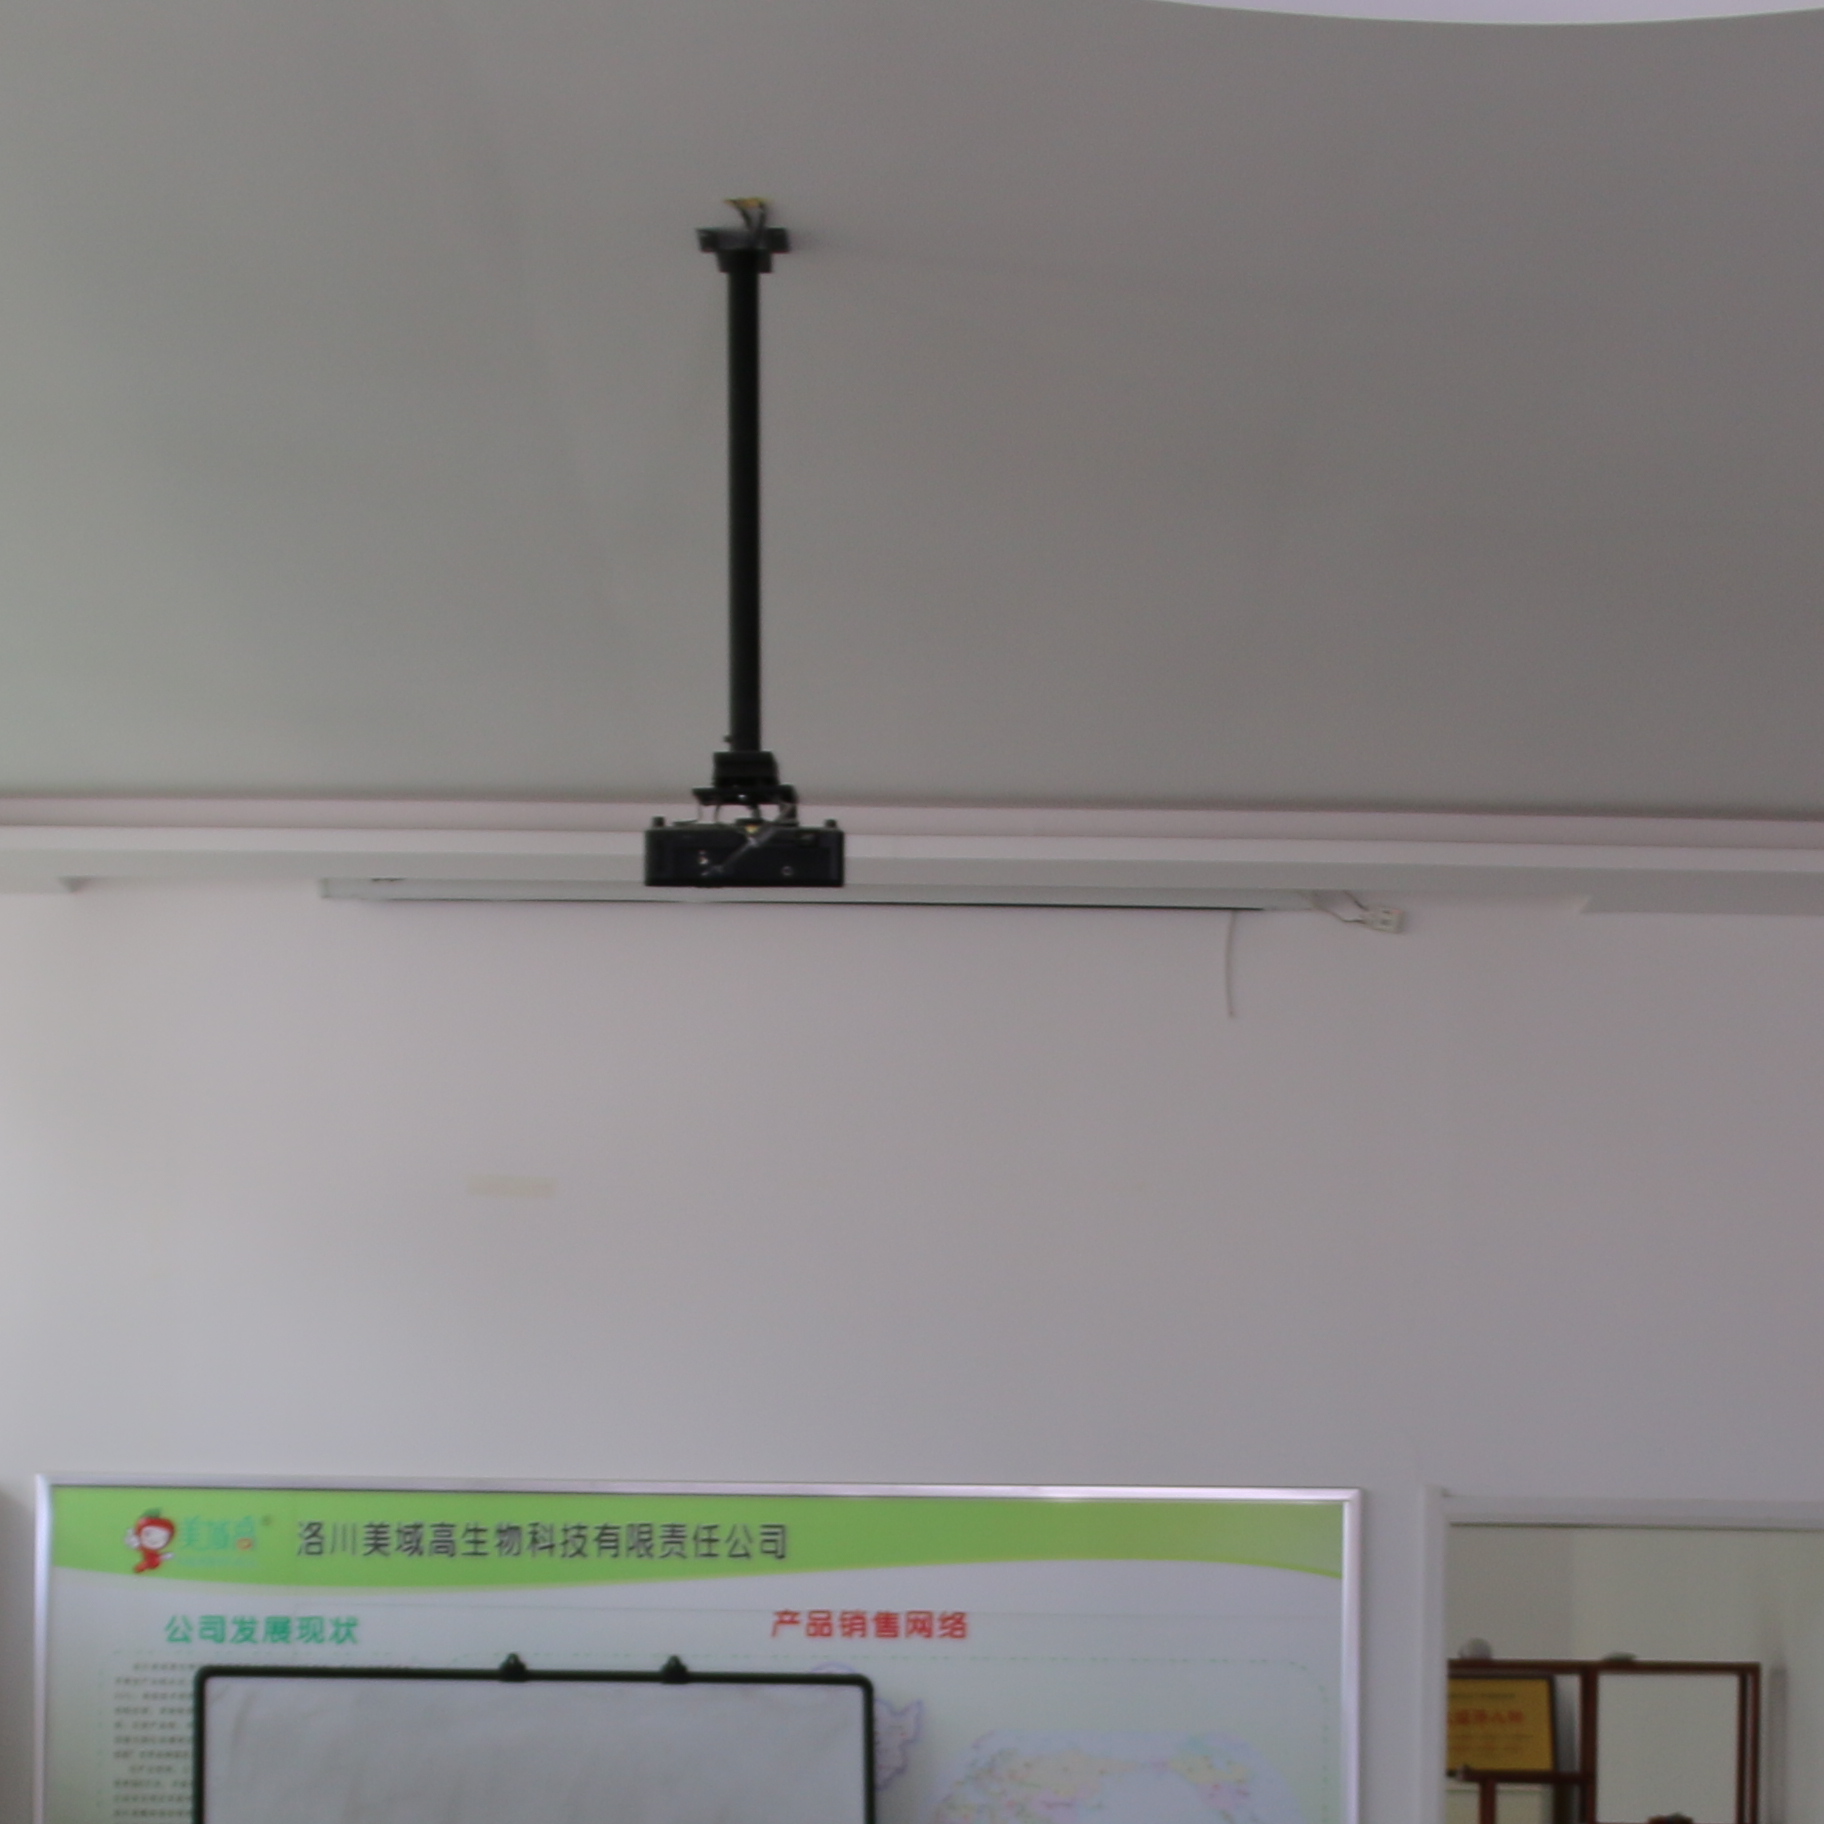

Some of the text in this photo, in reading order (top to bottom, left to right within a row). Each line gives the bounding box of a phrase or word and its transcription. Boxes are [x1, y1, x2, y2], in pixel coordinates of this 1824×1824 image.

[297, 1520, 789, 1560] 洛川美域高生物科技有限责任公司
[164, 1615, 360, 1645] 公司发展现状
[772, 1610, 969, 1640] 产品销售网络
